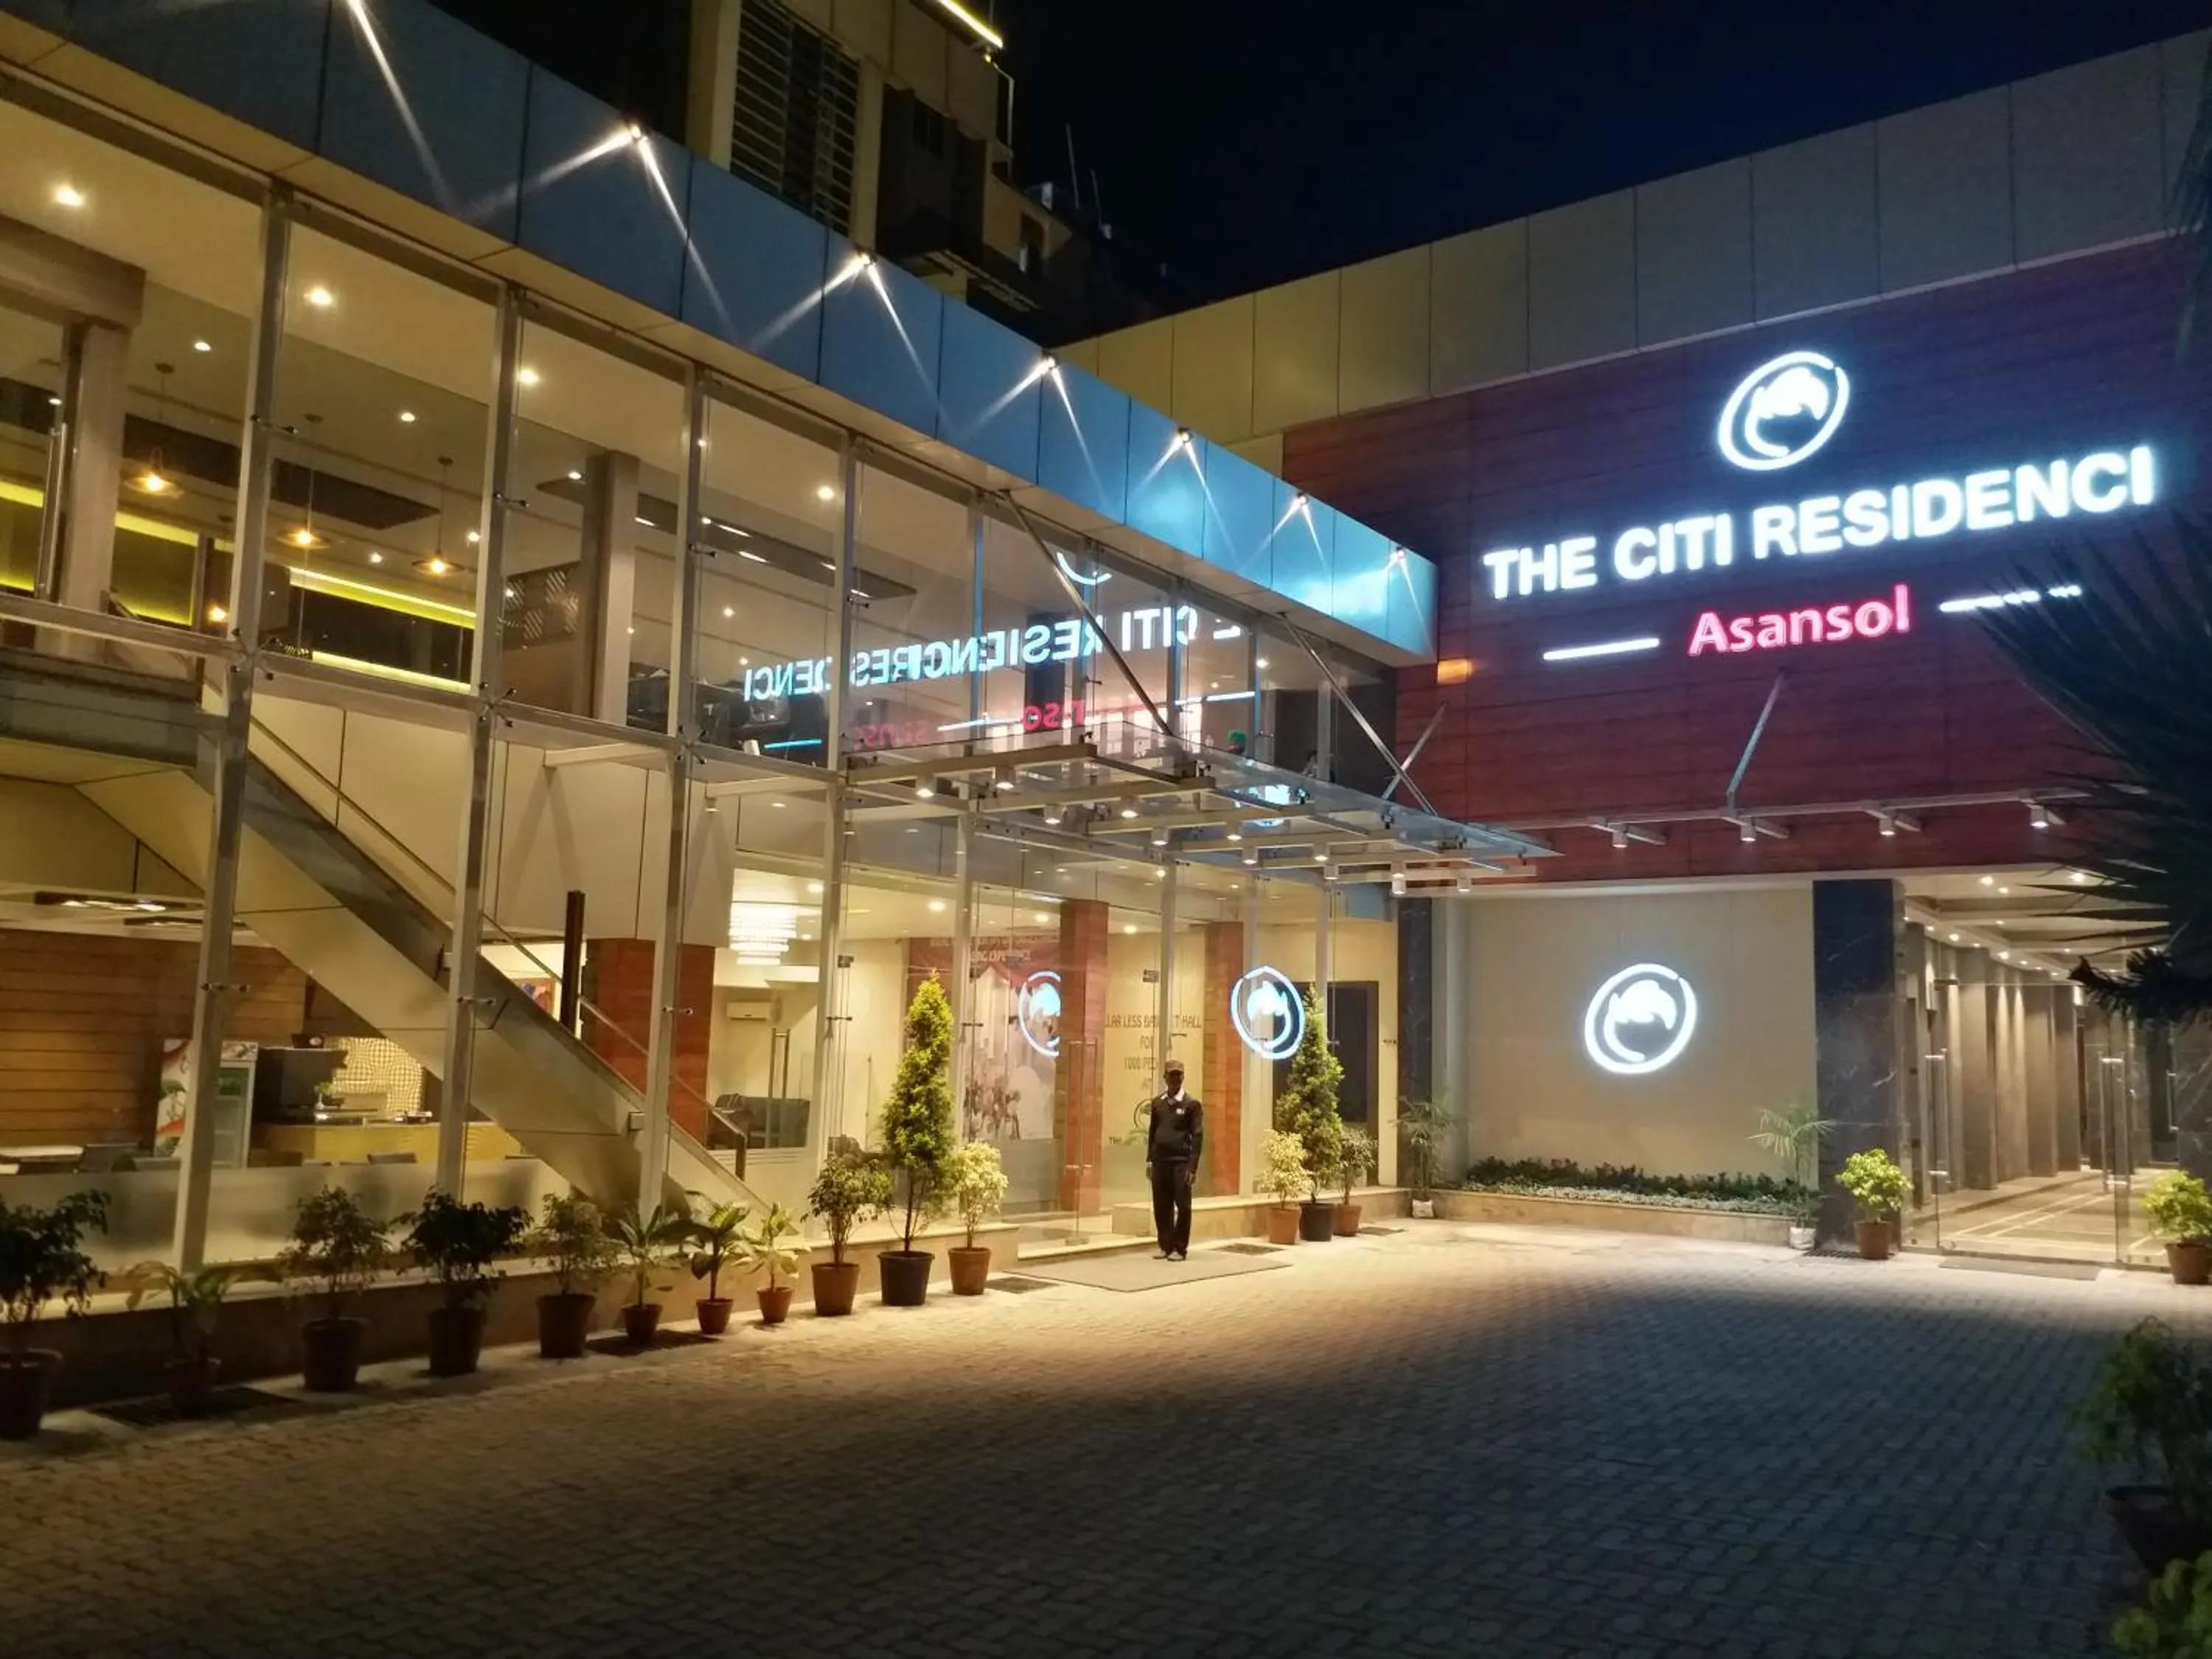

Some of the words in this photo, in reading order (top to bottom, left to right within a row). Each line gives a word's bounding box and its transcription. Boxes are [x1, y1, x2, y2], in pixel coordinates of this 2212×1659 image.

[1482, 536, 1598, 600] THE
[1613, 512, 1733, 581] CITI
[1752, 445, 2156, 560] RESIDENCI
[1687, 583, 1910, 656] Asansol
